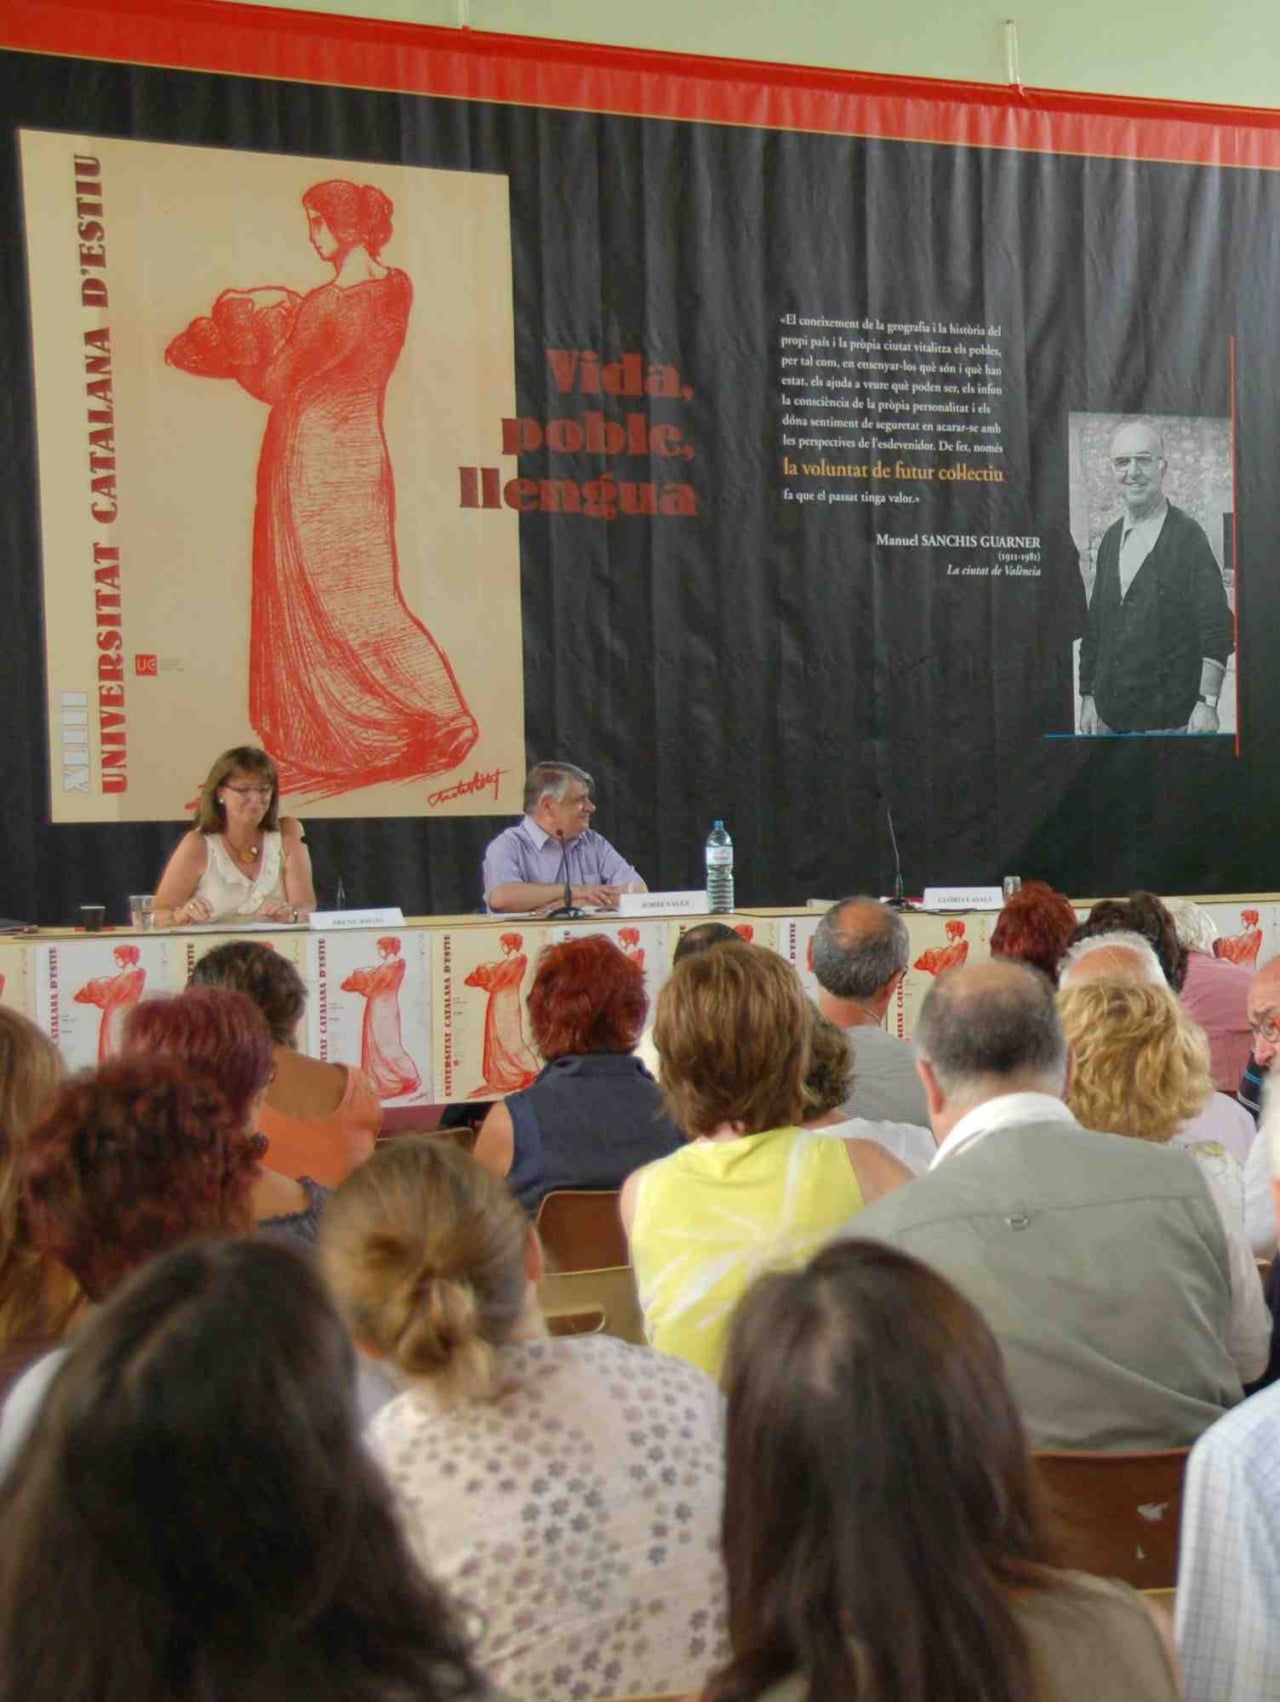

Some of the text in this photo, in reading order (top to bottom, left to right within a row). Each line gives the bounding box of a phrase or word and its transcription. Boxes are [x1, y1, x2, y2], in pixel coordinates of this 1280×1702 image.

[799, 316, 859, 329] coneixement
[862, 318, 874, 330] de
[876, 319, 885, 330] la
[887, 321, 931, 335] geografia
[938, 322, 948, 334] la
[949, 323, 985, 336] història
[987, 325, 1002, 337] del
[781, 335, 808, 348] propi
[810, 336, 830, 349] país
[838, 337, 848, 348] la
[850, 337, 881, 353] pròpia
[883, 339, 911, 351] ciutat
[913, 341, 952, 354] vitalitza
[954, 343, 967, 354] els
[545, 348, 695, 403] Vida,
[781, 357, 799, 368] per
[800, 356, 813, 367] tal
[842, 360, 854, 368] en
[919, 362, 937, 375] què
[939, 362, 956, 374] són
[964, 363, 983, 377] què
[985, 364, 1002, 376] han
[810, 375, 823, 387] els
[825, 376, 852, 390] ajuda
[854, 381, 861, 389] a
[863, 381, 889, 390] veure
[891, 380, 910, 394] què
[912, 381, 942, 395] poden
[962, 383, 975, 394] els
[782, 394, 791, 406] la
[852, 397, 864, 409] de
[867, 398, 876, 409] la
[878, 399, 911, 413] pròpia
[913, 402, 969, 414] personalitat
[977, 402, 991, 414] els
[782, 413, 1002, 434] dóna sentiment de seguretat en acarar-se amb
[783, 434, 796, 446] les
[798, 436, 856, 450] perspectives
[858, 437, 870, 448] de
[938, 440, 954, 452] De
[973, 442, 1004, 454] només
[74, 154, 128, 795] UNIVERSITAT CATALANA D'ESTIU
[783, 457, 798, 475] la
[802, 458, 868, 477] voluntat
[872, 460, 891, 478] de
[895, 461, 935, 480] futur
[458, 466, 698, 521] llengua
[783, 488, 794, 500] fa
[796, 492, 815, 503] que
[817, 490, 826, 501] el
[828, 493, 858, 504] passat
[861, 491, 886, 505] tinga
[876, 533, 1041, 549] Manuel SANCHIS GUARNER
[947, 564, 960, 575] La
[961, 565, 989, 576] ciutat
[991, 565, 1002, 576] de
